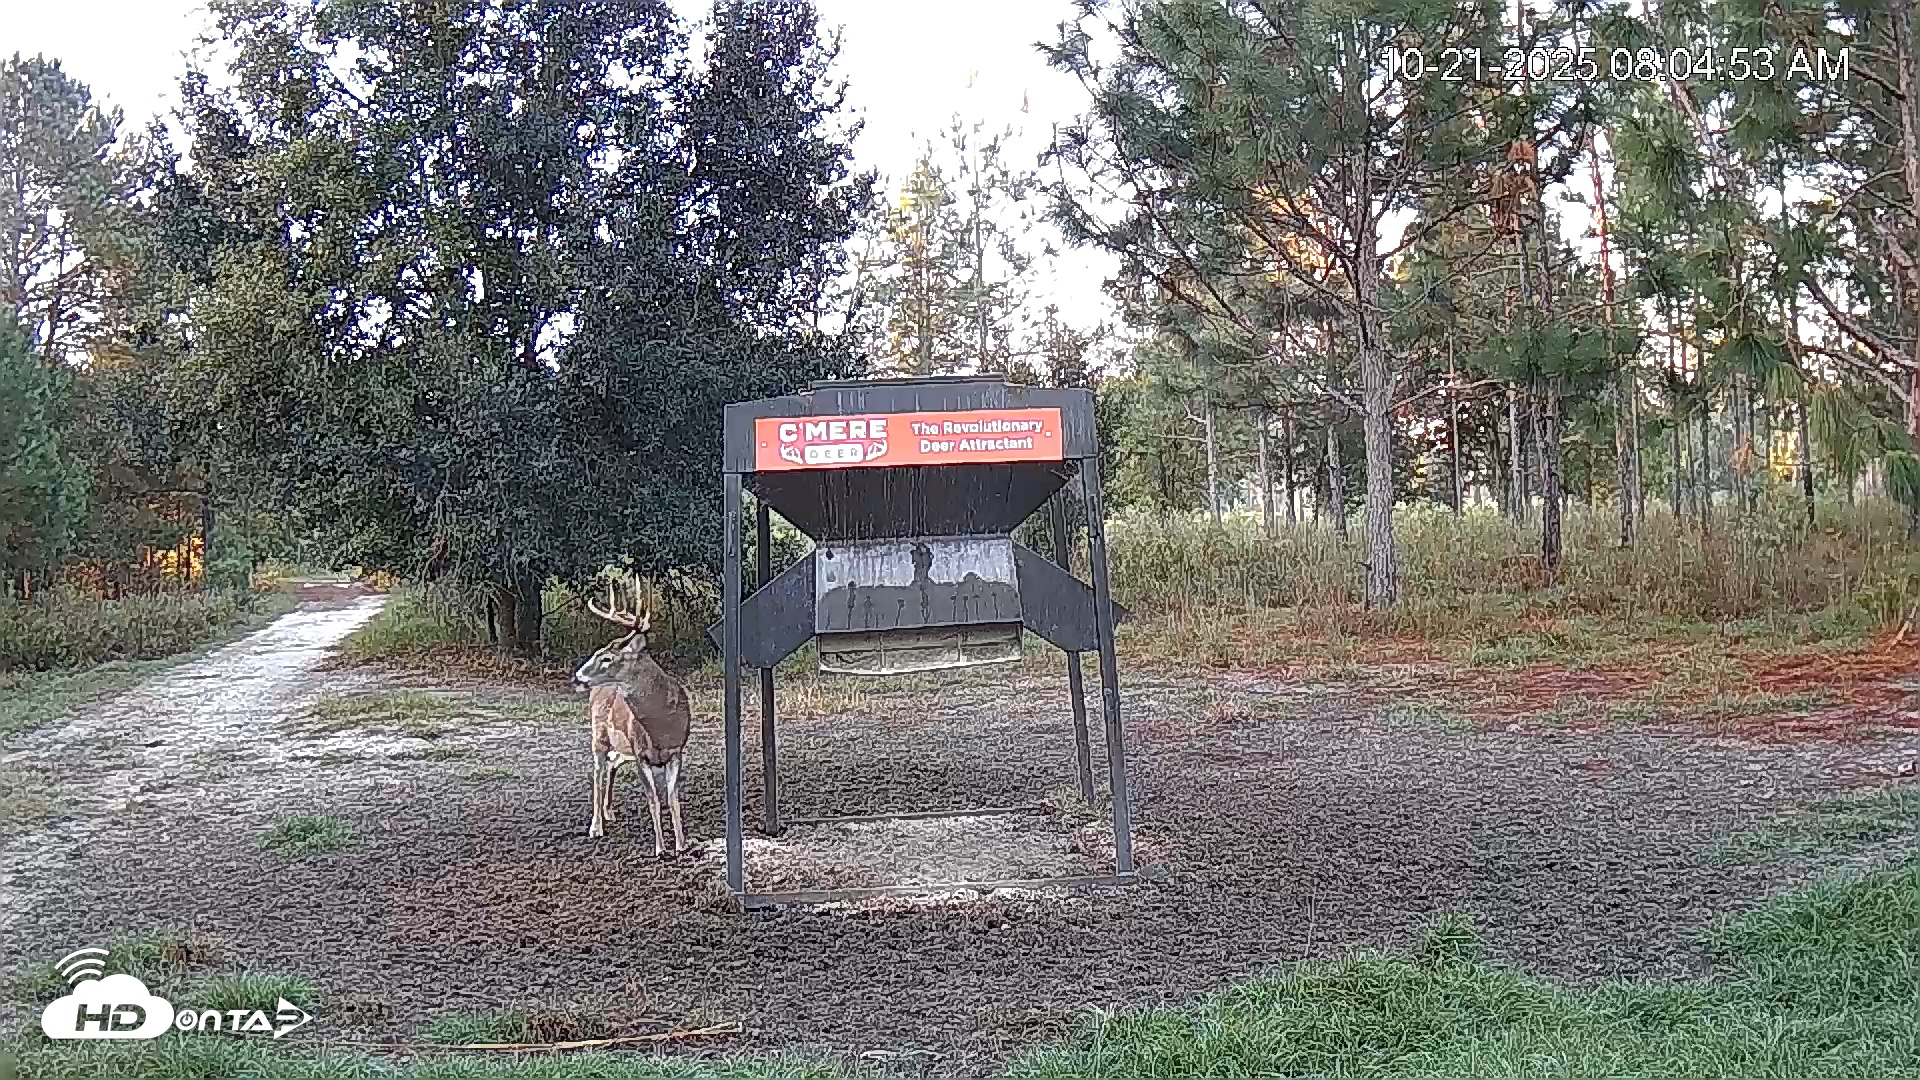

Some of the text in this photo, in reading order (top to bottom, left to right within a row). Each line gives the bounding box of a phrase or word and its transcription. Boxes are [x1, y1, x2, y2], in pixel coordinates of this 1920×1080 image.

[779, 419, 888, 443] C'MERE
[911, 419, 1043, 435] The Revolutionary
[920, 436, 1033, 453] Deer Attractant
